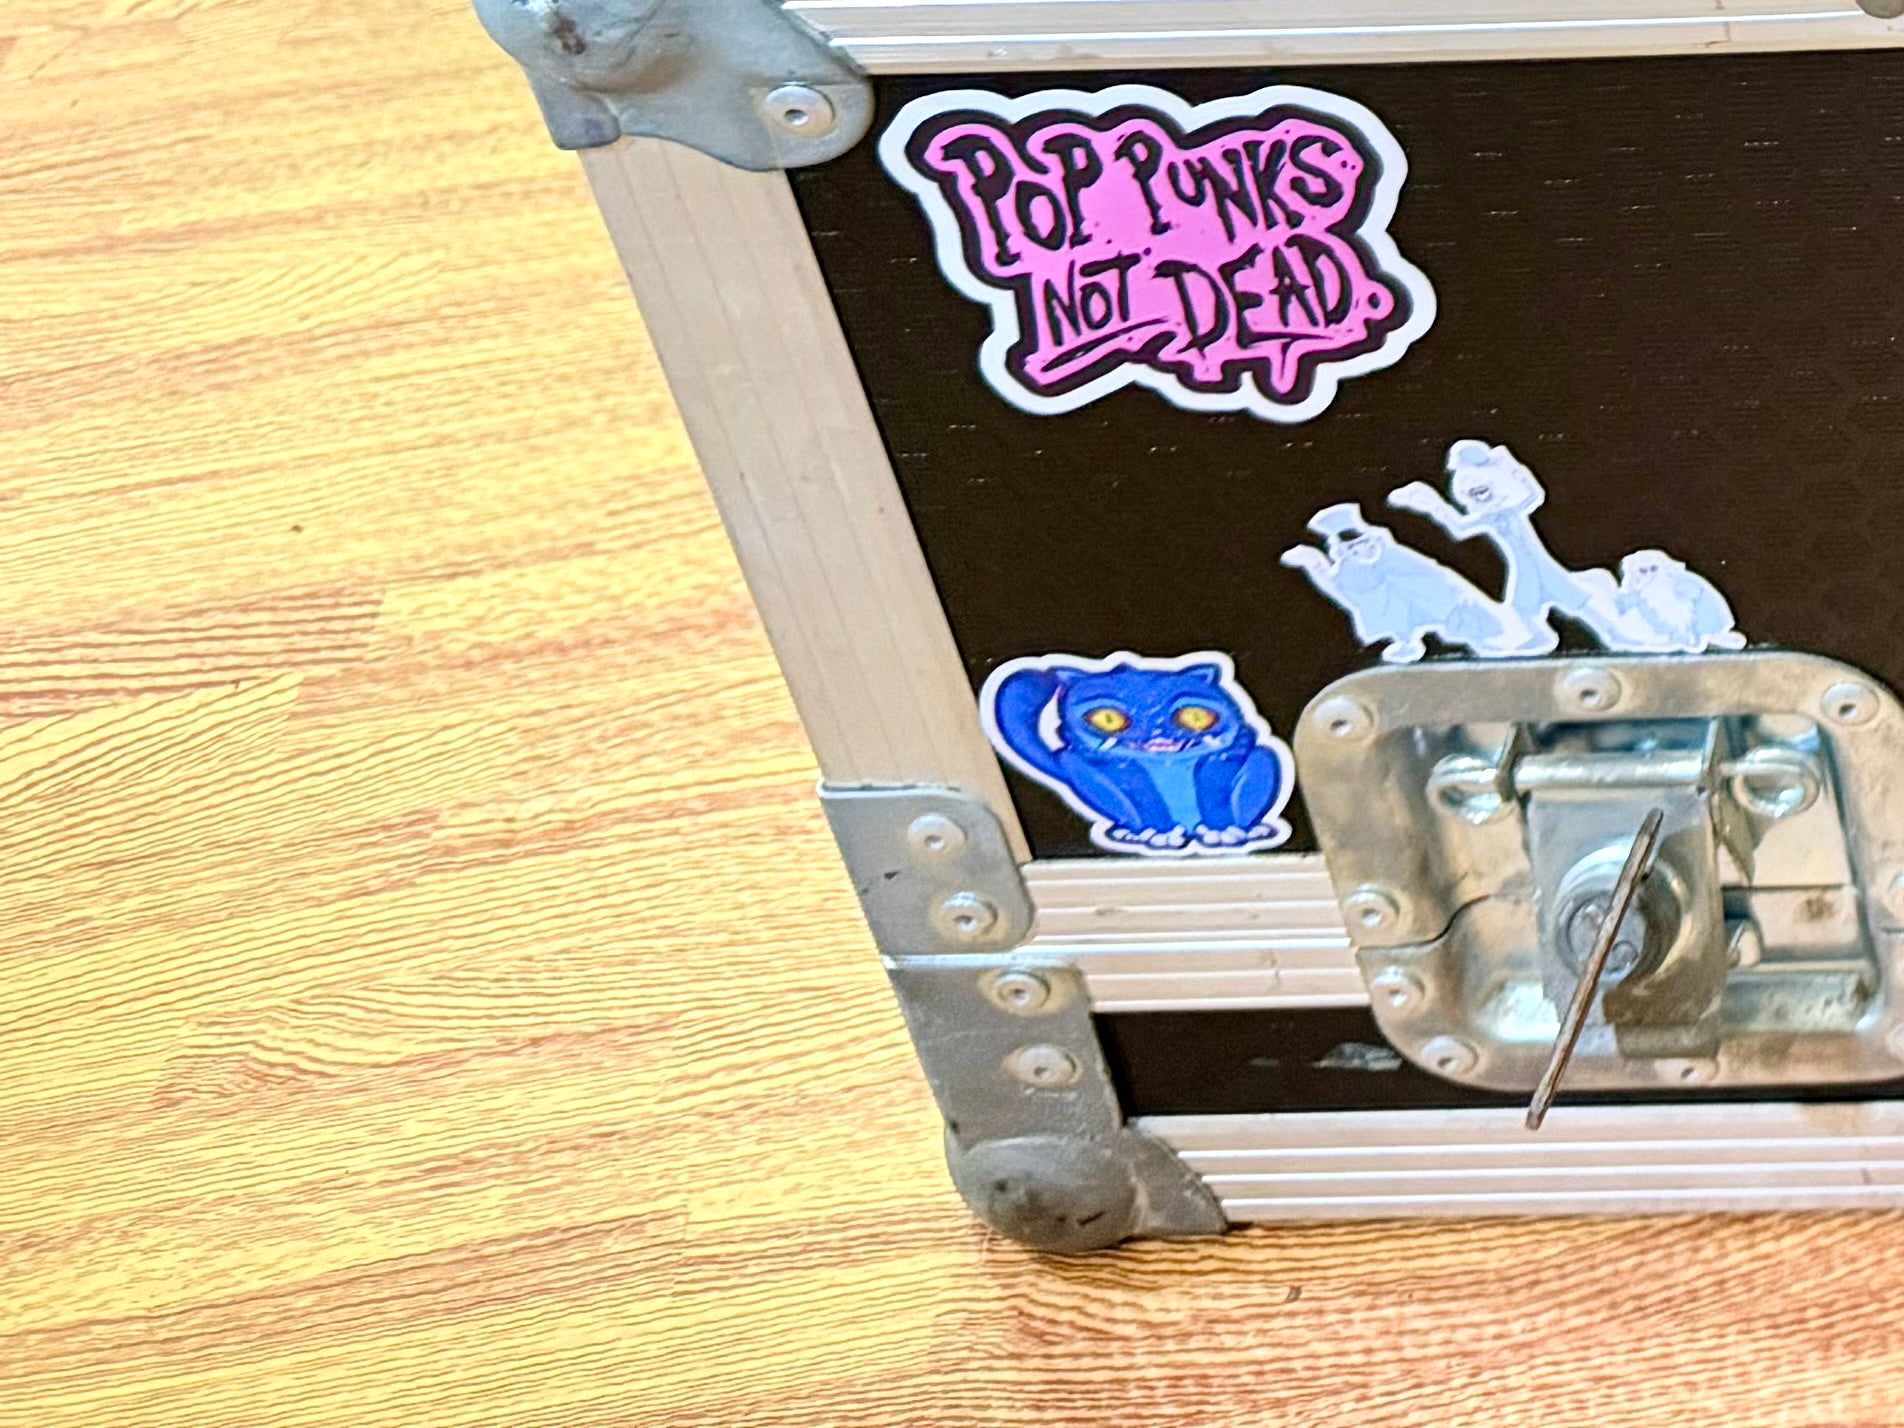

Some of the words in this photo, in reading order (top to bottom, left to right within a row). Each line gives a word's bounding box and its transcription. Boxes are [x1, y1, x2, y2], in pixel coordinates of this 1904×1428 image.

[941, 133, 1102, 266] POP
[1114, 128, 1347, 244] PUNKS
[1041, 251, 1142, 347] NOT
[1152, 233, 1355, 351] DEAD
